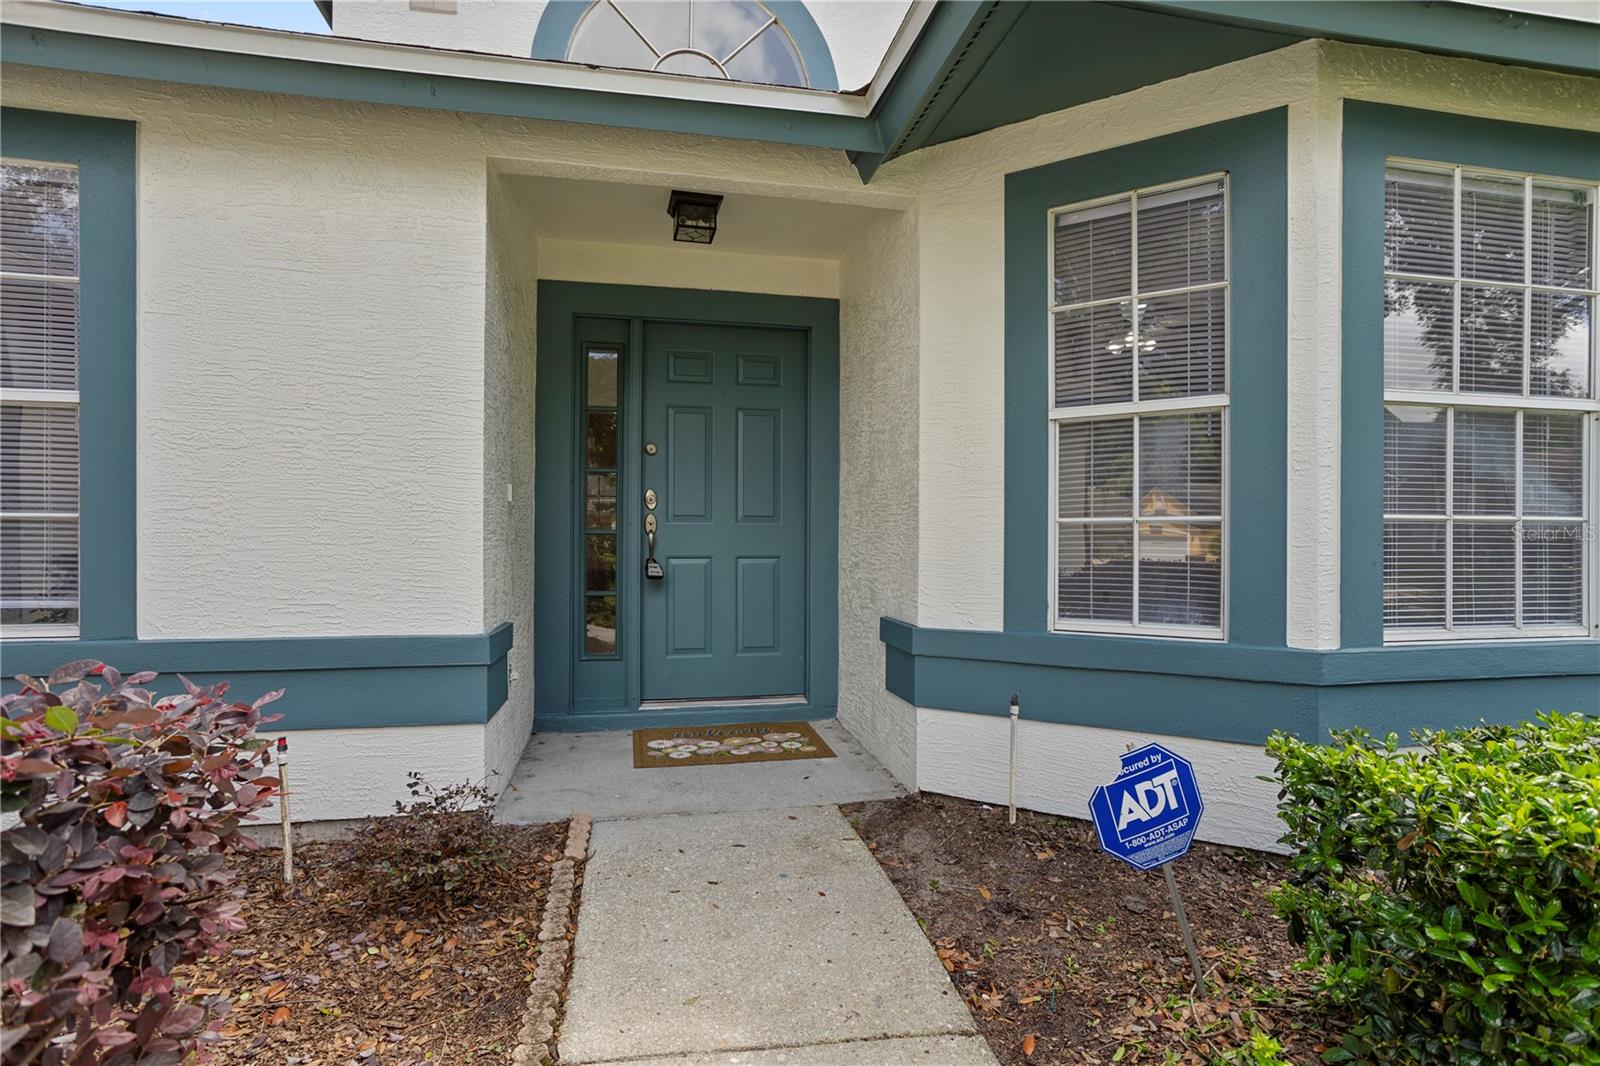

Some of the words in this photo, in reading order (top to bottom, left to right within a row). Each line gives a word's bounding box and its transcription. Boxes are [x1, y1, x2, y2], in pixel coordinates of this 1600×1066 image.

[1150, 753, 1162, 763] by
[1118, 769, 1178, 831] ADT
[1125, 818, 1189, 849] 1-800-ADT-ASAP
